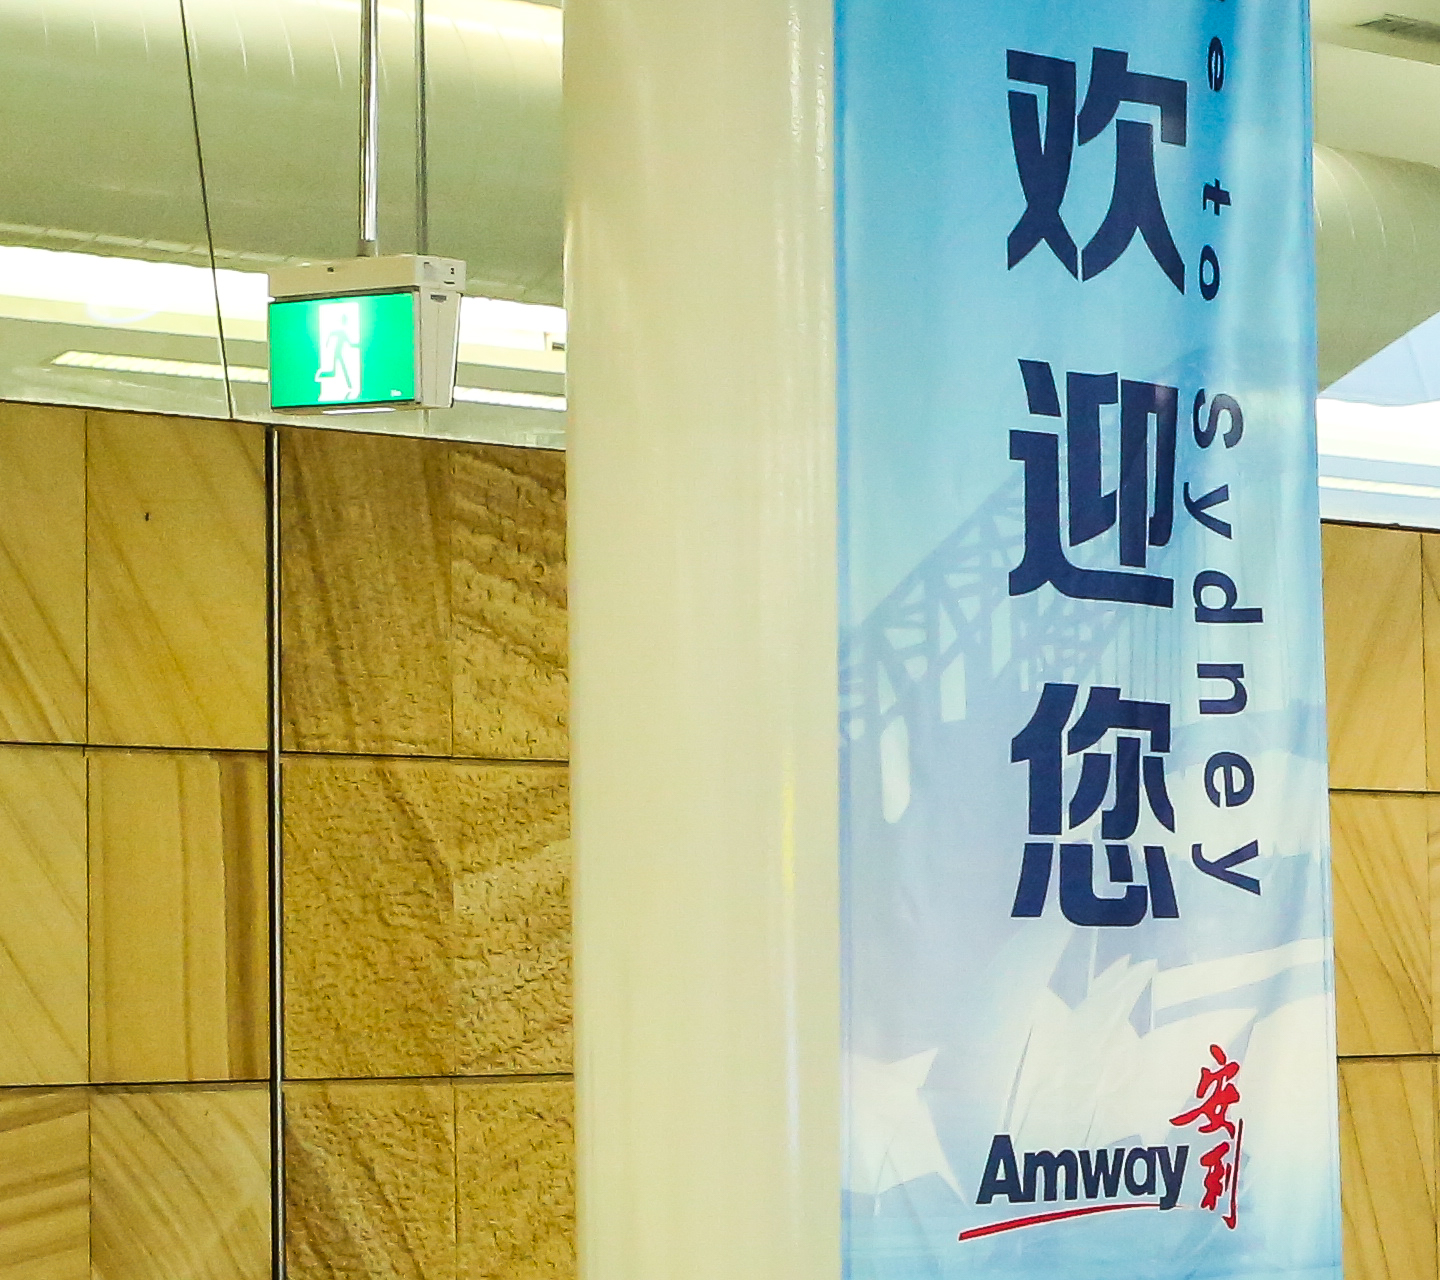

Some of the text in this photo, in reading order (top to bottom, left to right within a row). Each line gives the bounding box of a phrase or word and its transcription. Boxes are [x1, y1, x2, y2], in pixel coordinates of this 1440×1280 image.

[1198, 177, 1232, 302] to
[1182, 390, 1264, 897] Sydney
[975, 1133, 1190, 1211] Amway
